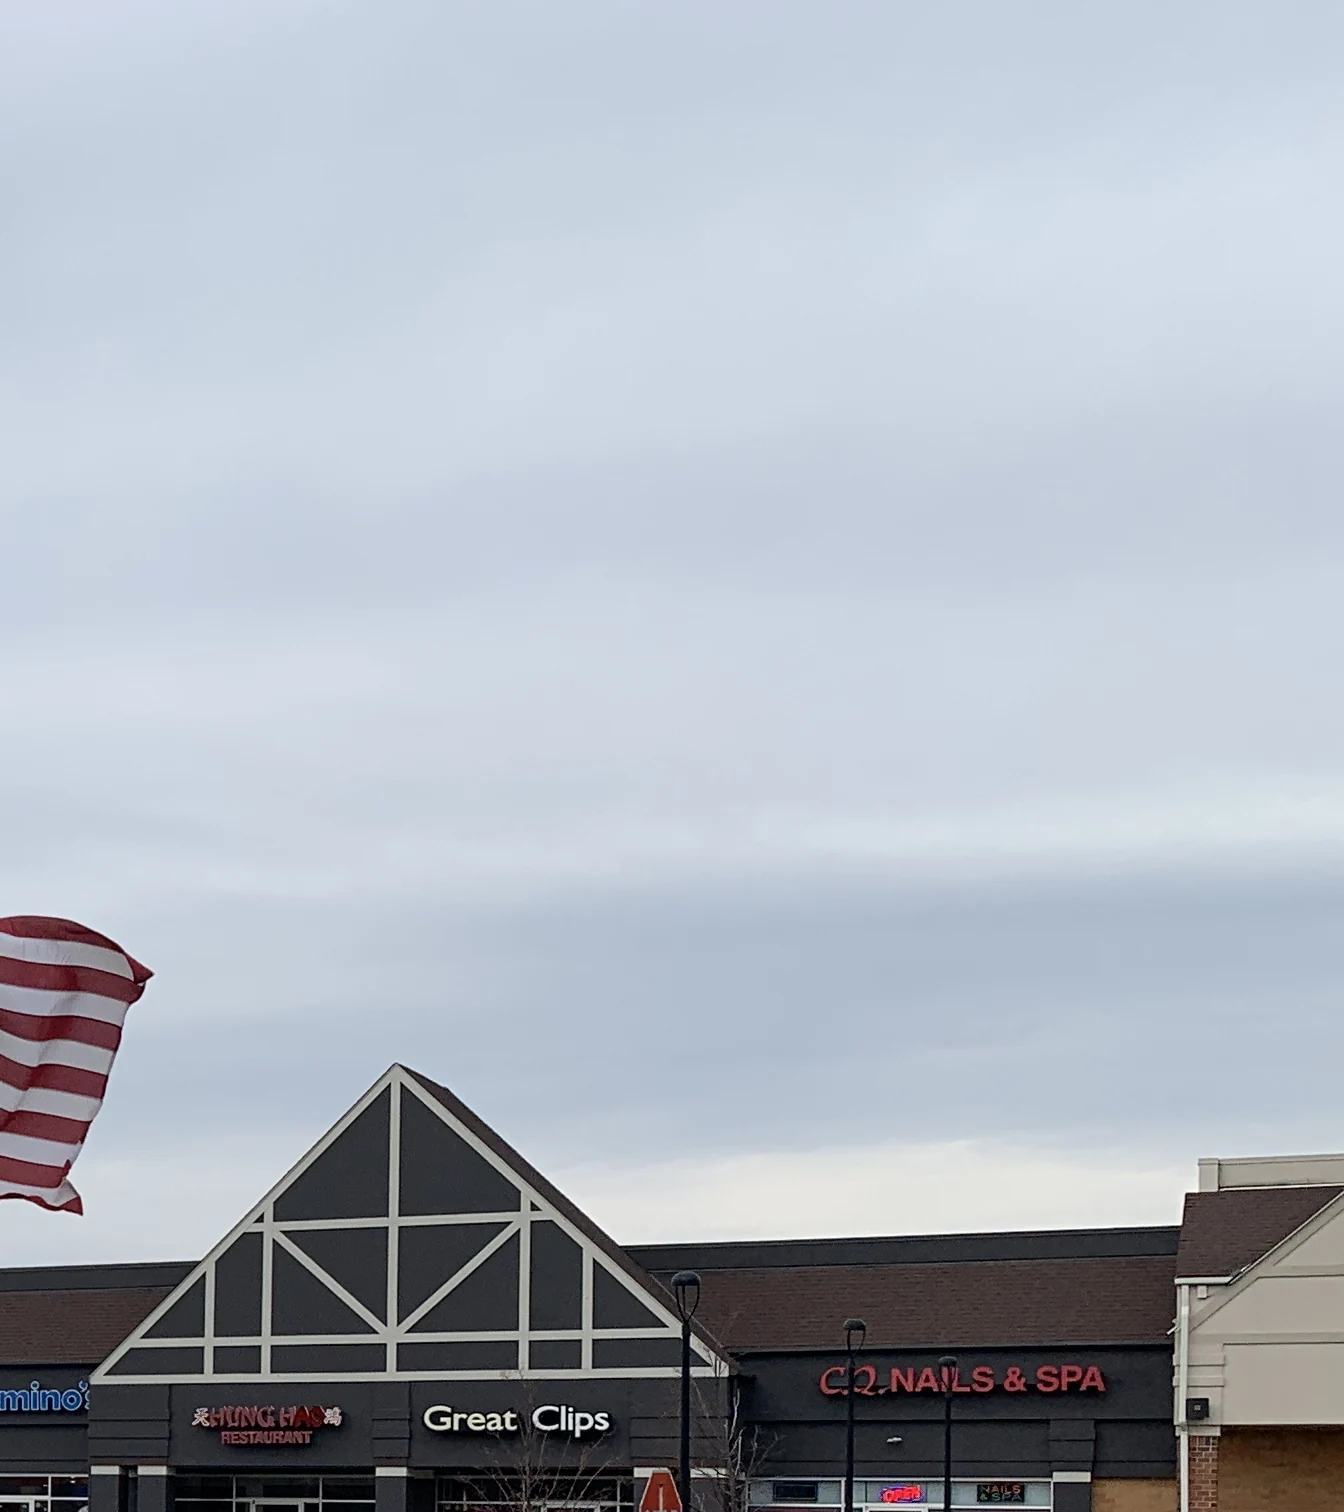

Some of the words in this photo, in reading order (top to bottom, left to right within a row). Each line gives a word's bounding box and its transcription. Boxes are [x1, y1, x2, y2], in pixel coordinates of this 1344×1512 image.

[890, 1366, 994, 1393] NAILS
[1003, 1367, 1027, 1392] &
[1037, 1365, 1106, 1392] SPA
[210, 1405, 275, 1428] HUNG
[279, 1405, 326, 1428] HAO
[423, 1405, 518, 1431] Great
[532, 1405, 610, 1438] Clips
[221, 1431, 312, 1444] RESTAURANT
[981, 1484, 1021, 1494] NAILS
